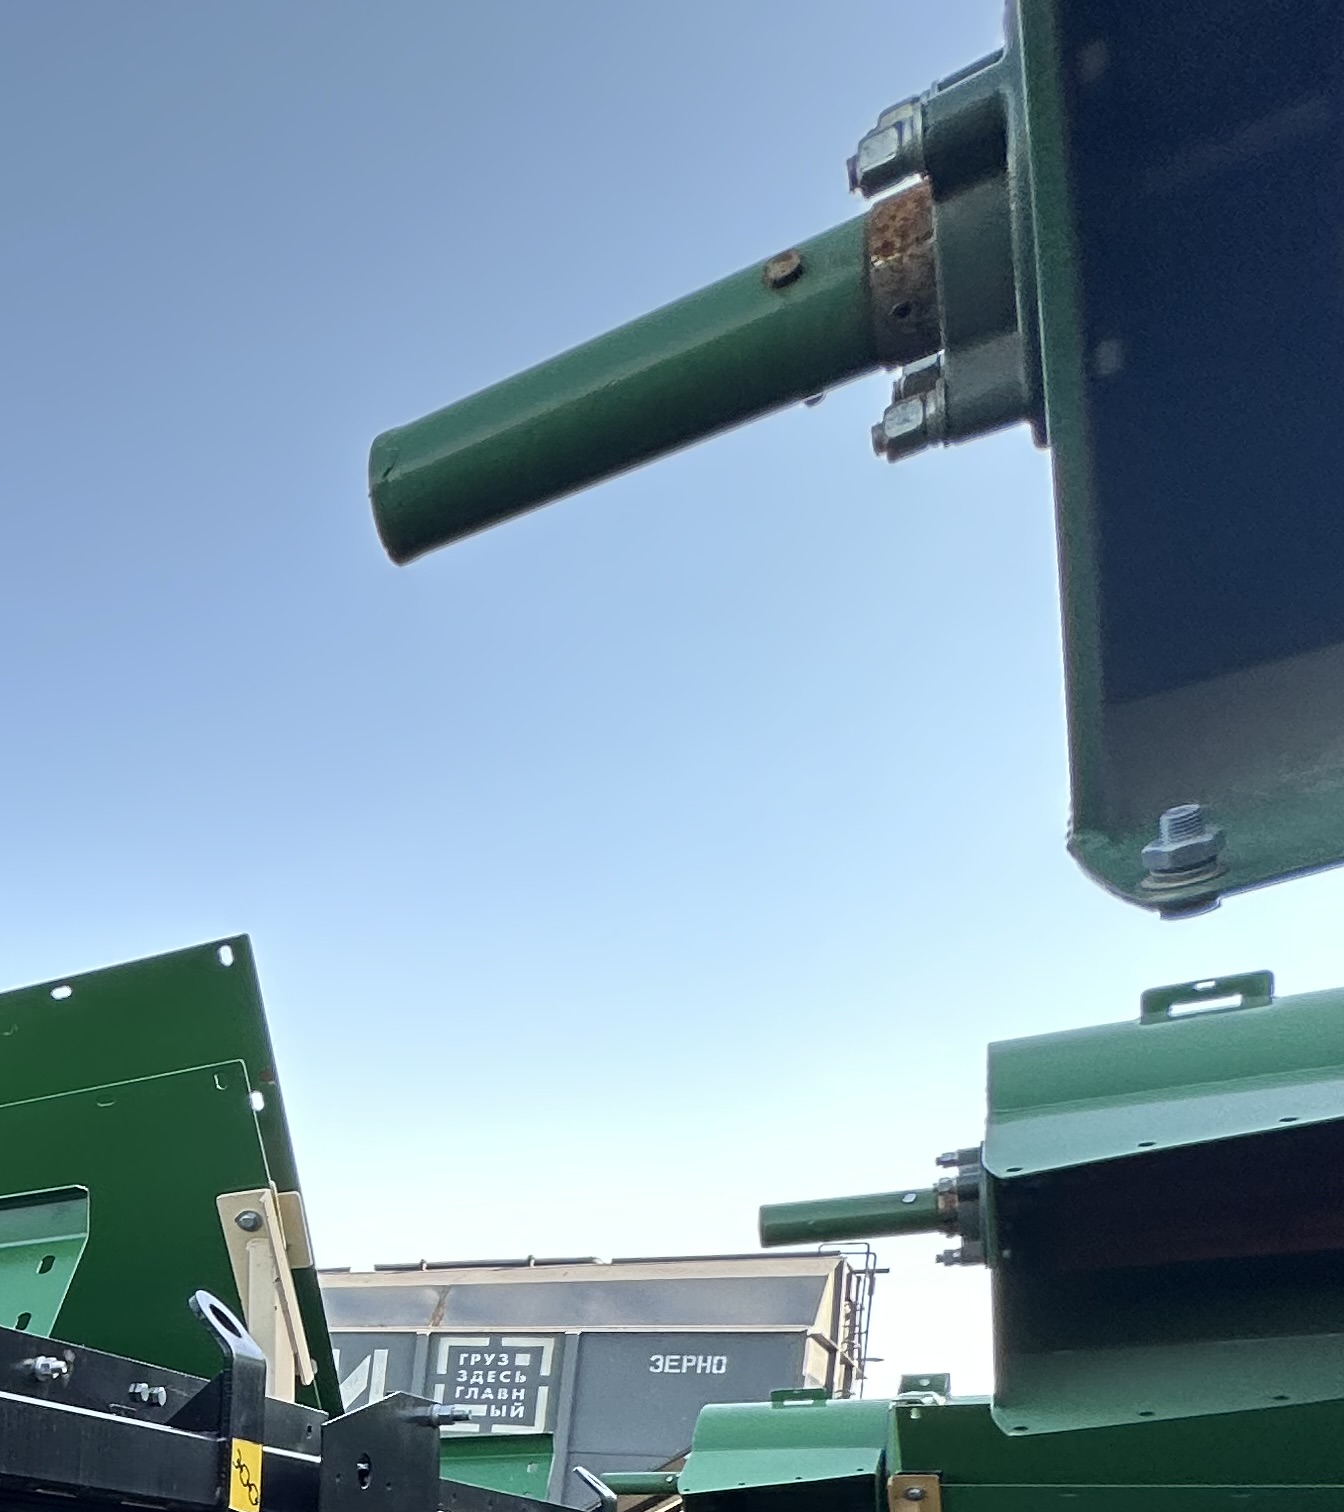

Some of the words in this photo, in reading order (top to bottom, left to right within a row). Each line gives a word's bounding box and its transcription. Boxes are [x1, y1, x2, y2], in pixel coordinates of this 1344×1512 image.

[459, 1353, 509, 1366] ГРУЗ
[649, 1354, 727, 1374] ЗЕРНО
[456, 1370, 527, 1385] ЗДЕСЬ
[455, 1386, 526, 1400] ГЛАВН
[489, 1402, 525, 1418] ЫЙ
